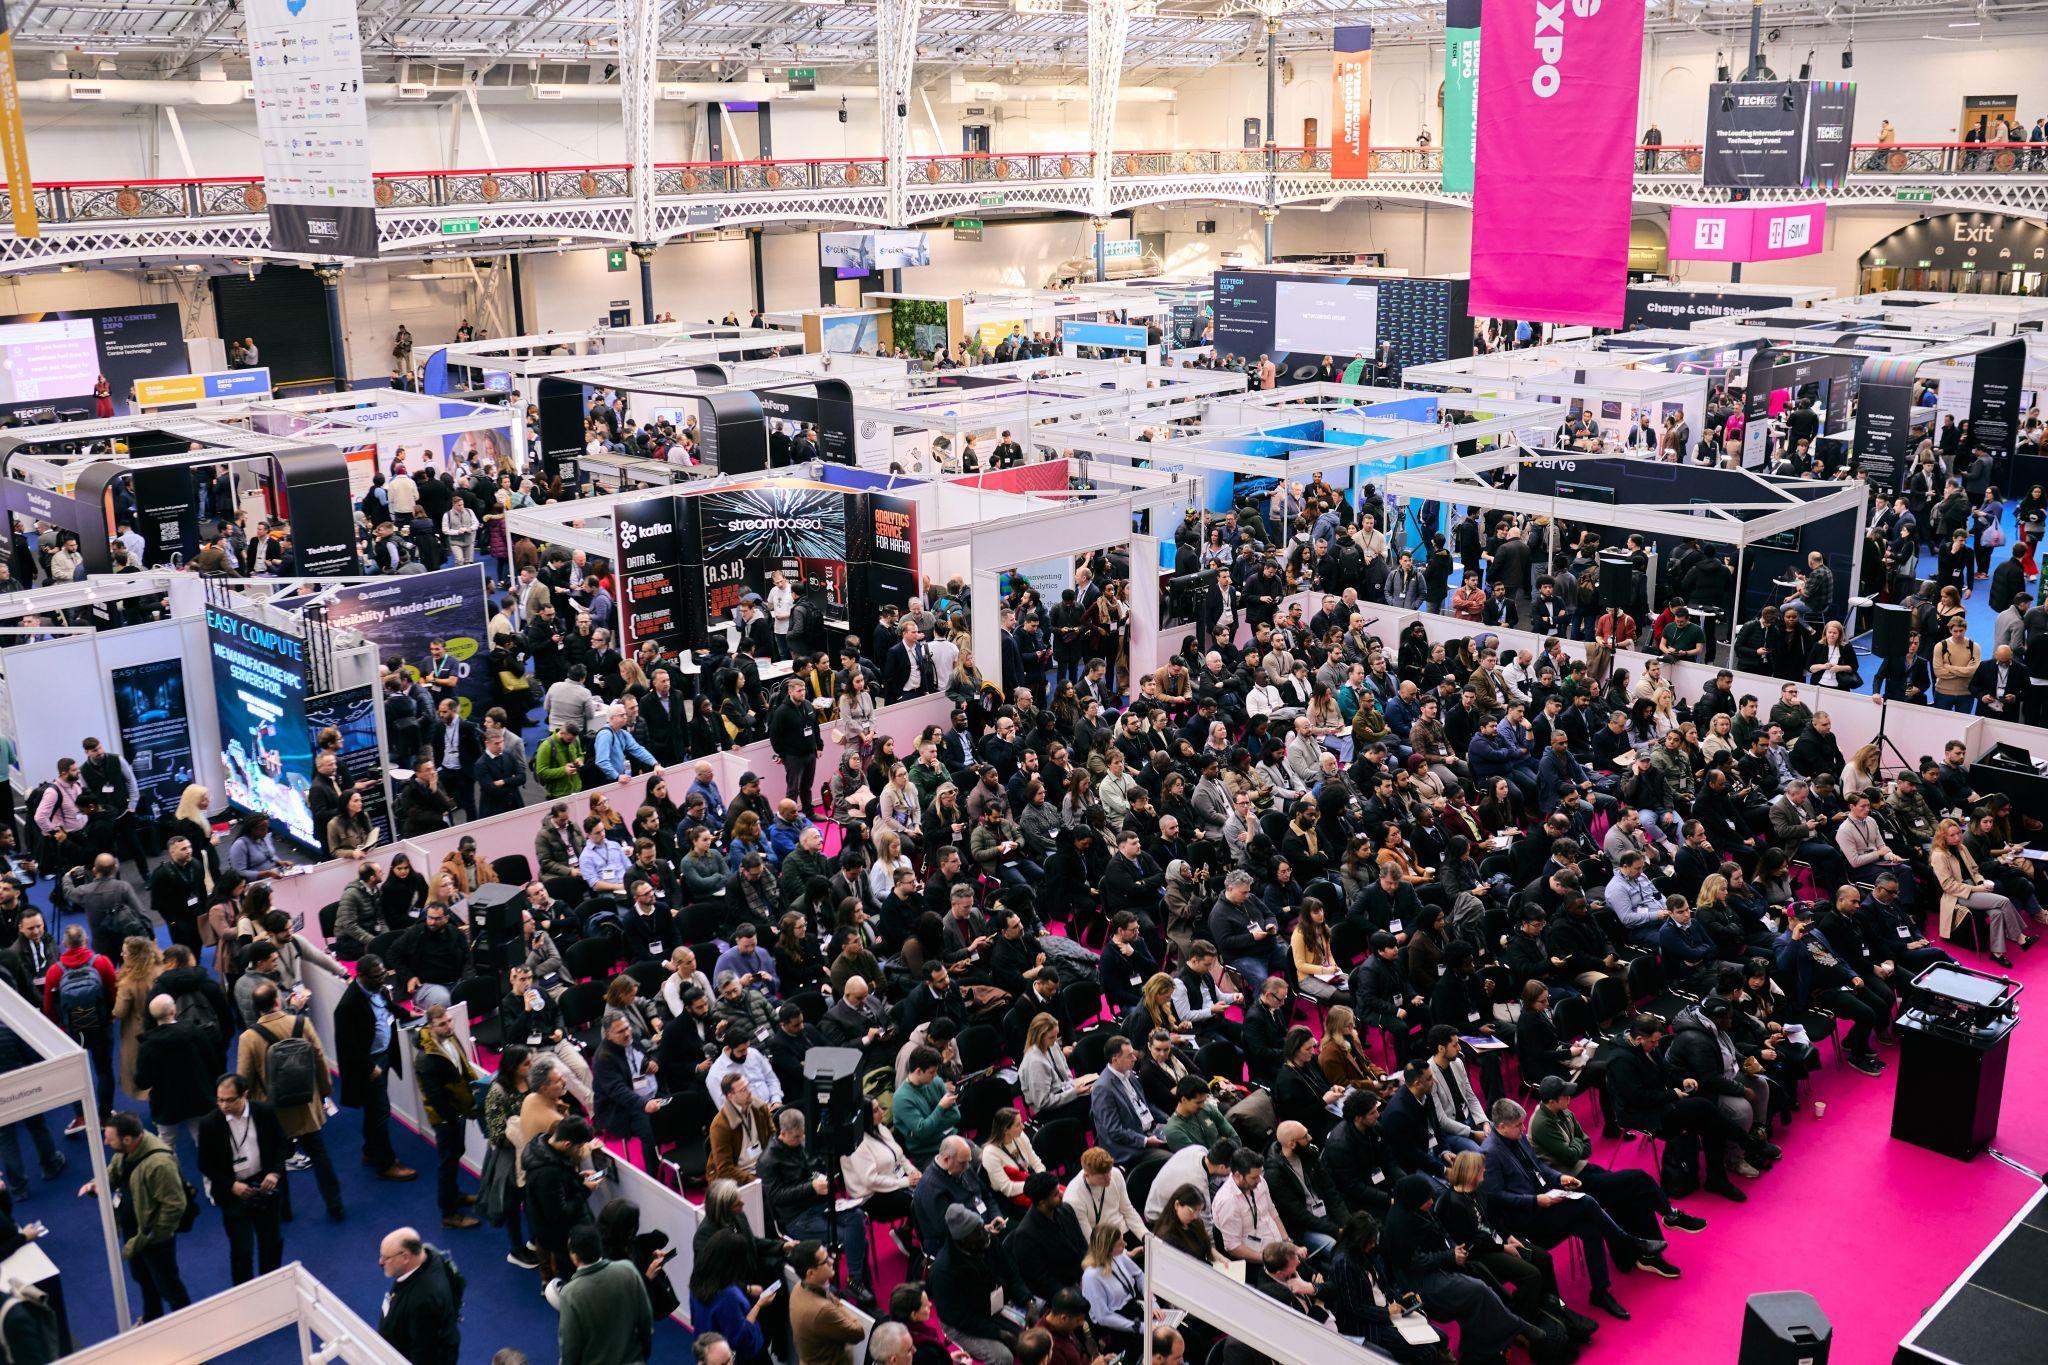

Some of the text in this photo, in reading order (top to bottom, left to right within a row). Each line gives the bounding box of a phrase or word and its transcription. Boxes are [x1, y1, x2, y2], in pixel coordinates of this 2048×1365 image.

[1532, 0, 1565, 97] XPO
[1463, 41, 1472, 78] EXPO
[1738, 95, 1777, 105] TECHEX
[1344, 113, 1353, 143] EXPO
[1352, 101, 1361, 156] SECURITY
[1817, 126, 1843, 139] TECHEX
[1728, 137, 1762, 145] Technology
[308, 221, 337, 234] TECHEX
[1954, 222, 1994, 243] Exit
[1648, 303, 1685, 316] Charge
[1687, 304, 1695, 313] &
[1698, 304, 1722, 315] Chill
[102, 313, 157, 323] DATA CENTRES
[124, 348, 152, 356] Technology
[356, 410, 399, 423] coursera
[1535, 457, 1576, 472] zerve
[875, 508, 909, 527] ANALYTICS
[639, 523, 672, 539] kafka
[728, 518, 823, 532] streambased.
[875, 524, 902, 538] SERVICE
[306, 544, 346, 555] TechForge
[876, 536, 911, 554] FOR KAFKA
[626, 555, 646, 569] DATA
[782, 560, 799, 568] KAFKA
[1029, 573, 1062, 582] inventing
[368, 586, 401, 600] sensolus
[333, 594, 463, 628] visibility. Made simple
[206, 609, 238, 636] EASY
[241, 623, 302, 662] COMPUTE
[213, 642, 227, 659] WE
[226, 648, 283, 682] MANUFACTURE
[283, 670, 302, 689] HPC
[113, 669, 136, 678] EASY
[230, 665, 264, 689] SERVERS
